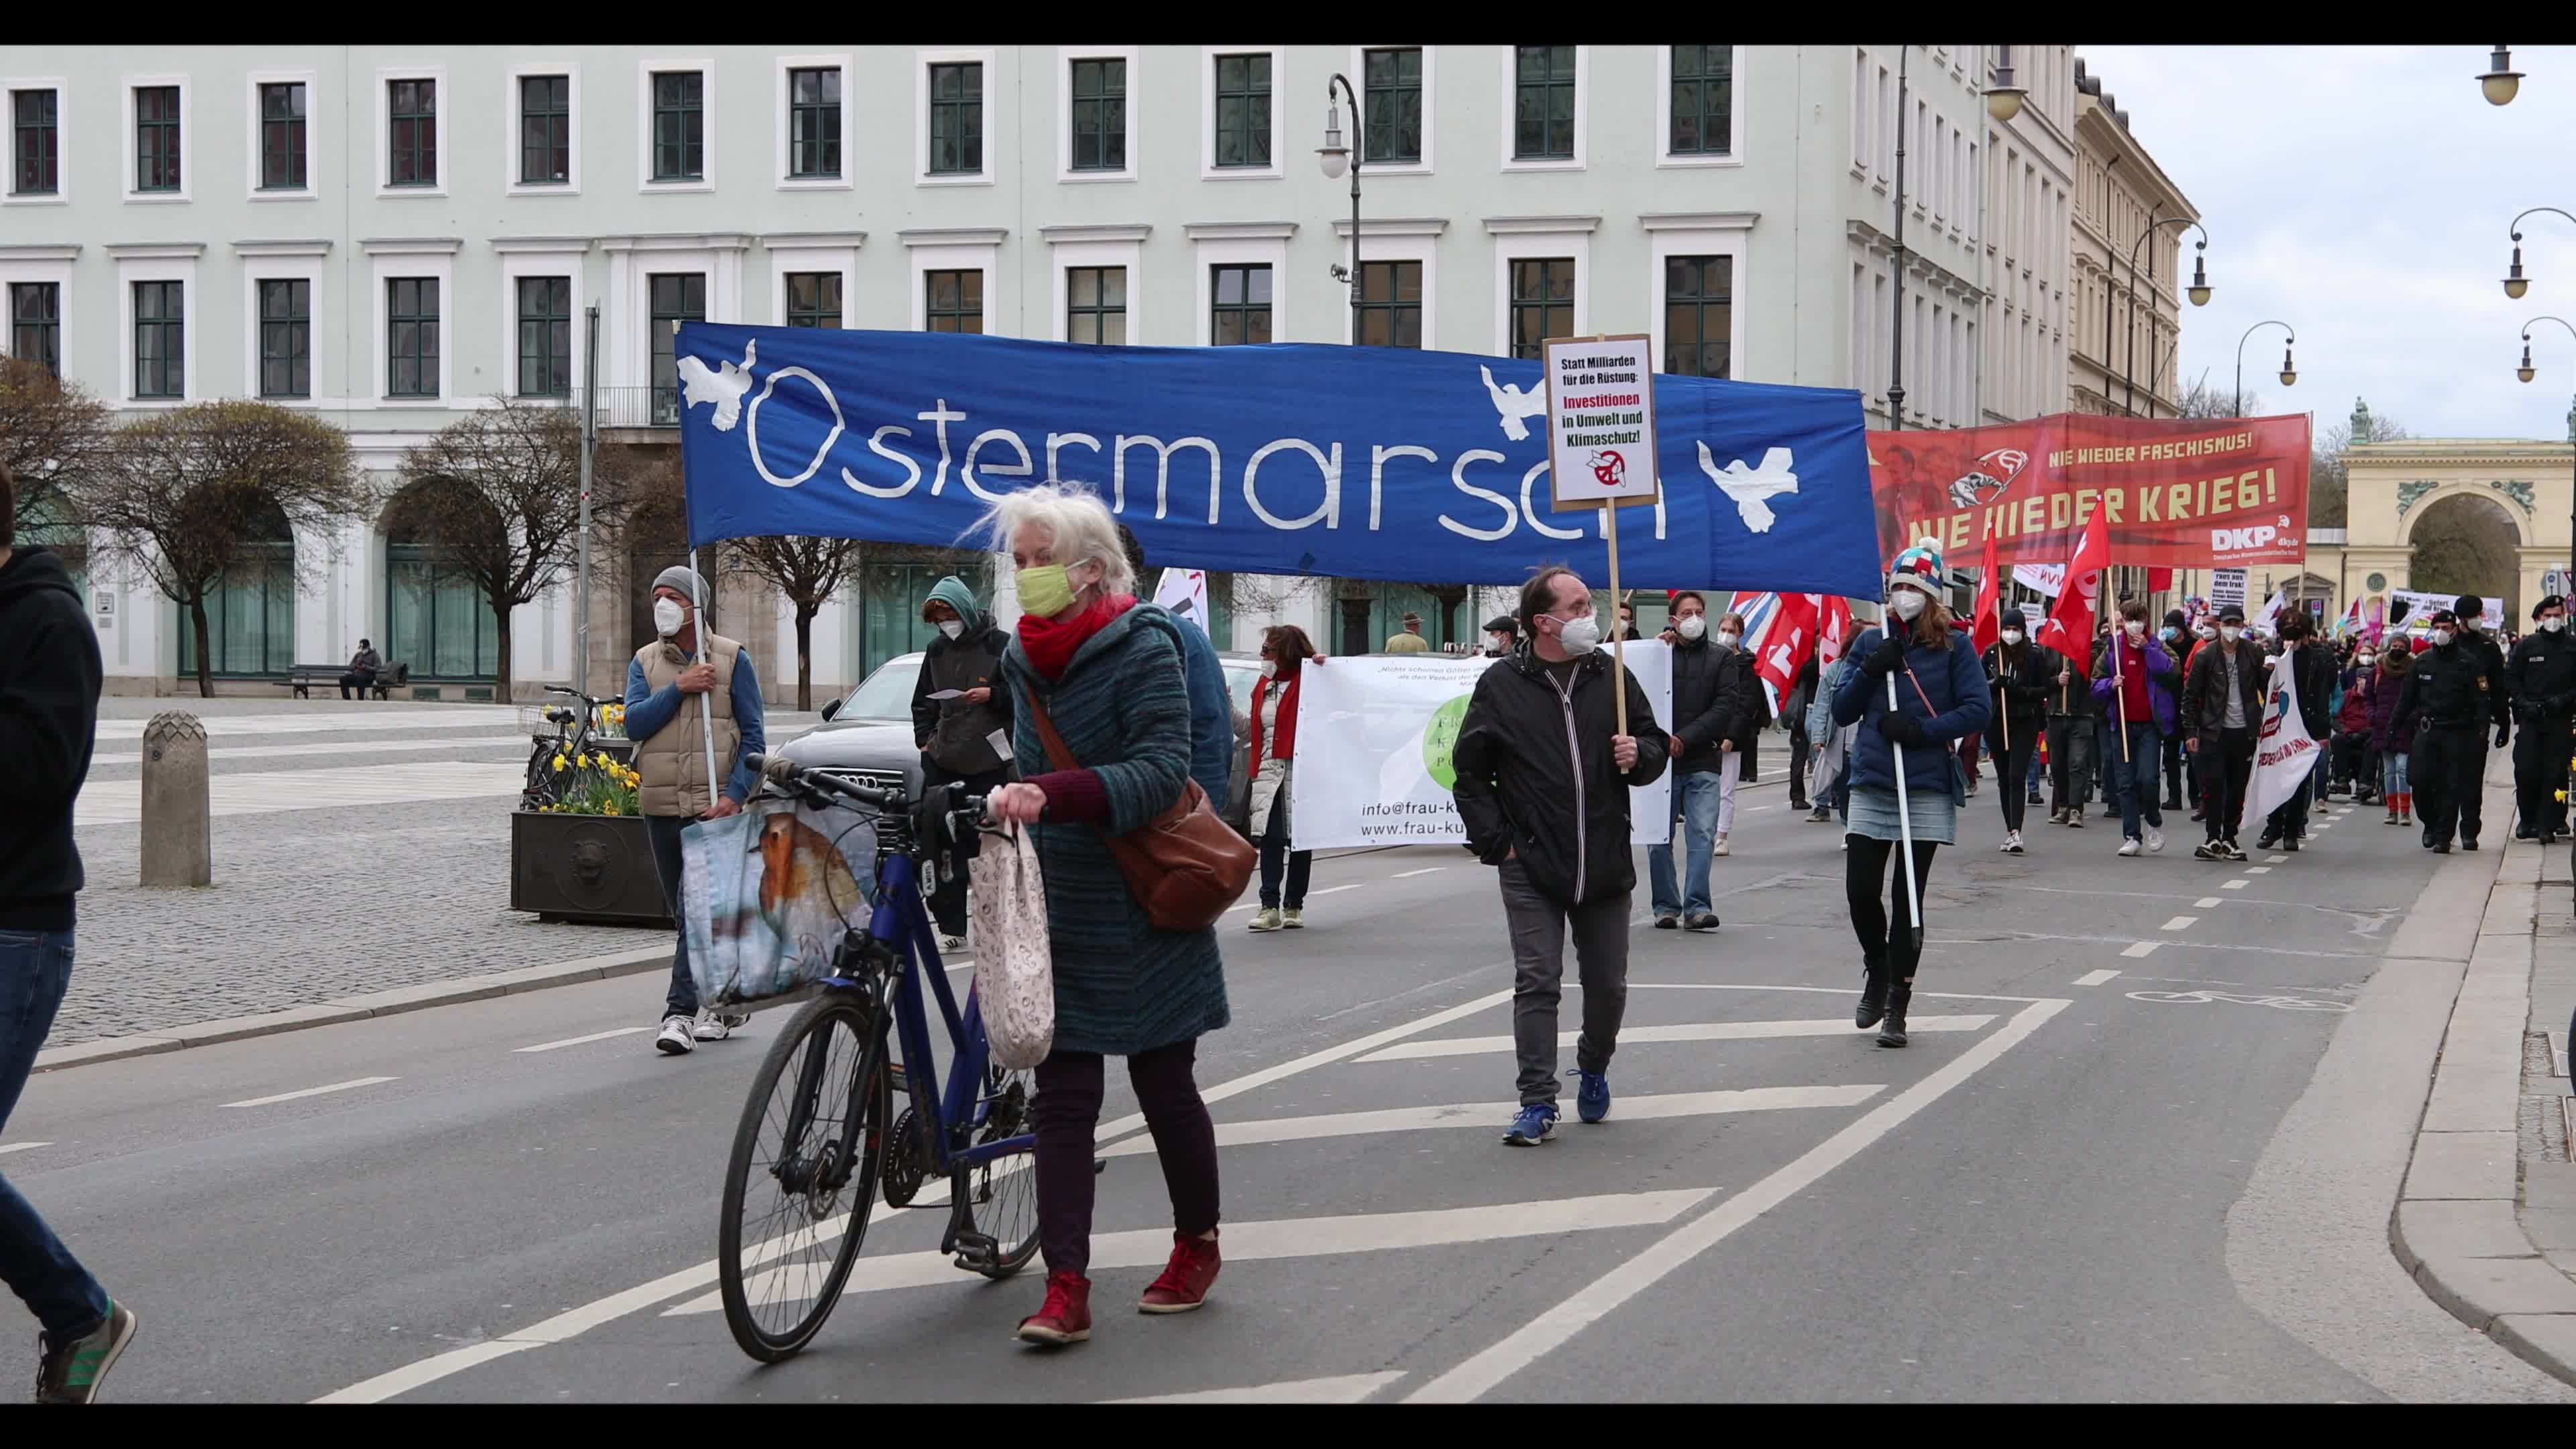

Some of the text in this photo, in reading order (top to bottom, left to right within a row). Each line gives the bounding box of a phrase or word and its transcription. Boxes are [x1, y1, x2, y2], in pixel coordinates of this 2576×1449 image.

[1561, 356, 1635, 370] Statt Milliarden
[1563, 372, 1639, 386] für die Rüstung:
[1563, 393, 1640, 409] Investitionen
[1562, 411, 1643, 428] in Umwelt und
[1566, 430, 1640, 447] Klimaschutz!
[2049, 431, 2253, 468] NIE WIEDER FASCHISMUS!
[2139, 468, 2276, 523] KRIEG!
[2211, 525, 2276, 551] DKP
[1362, 800, 1456, 816] info@frau-k
